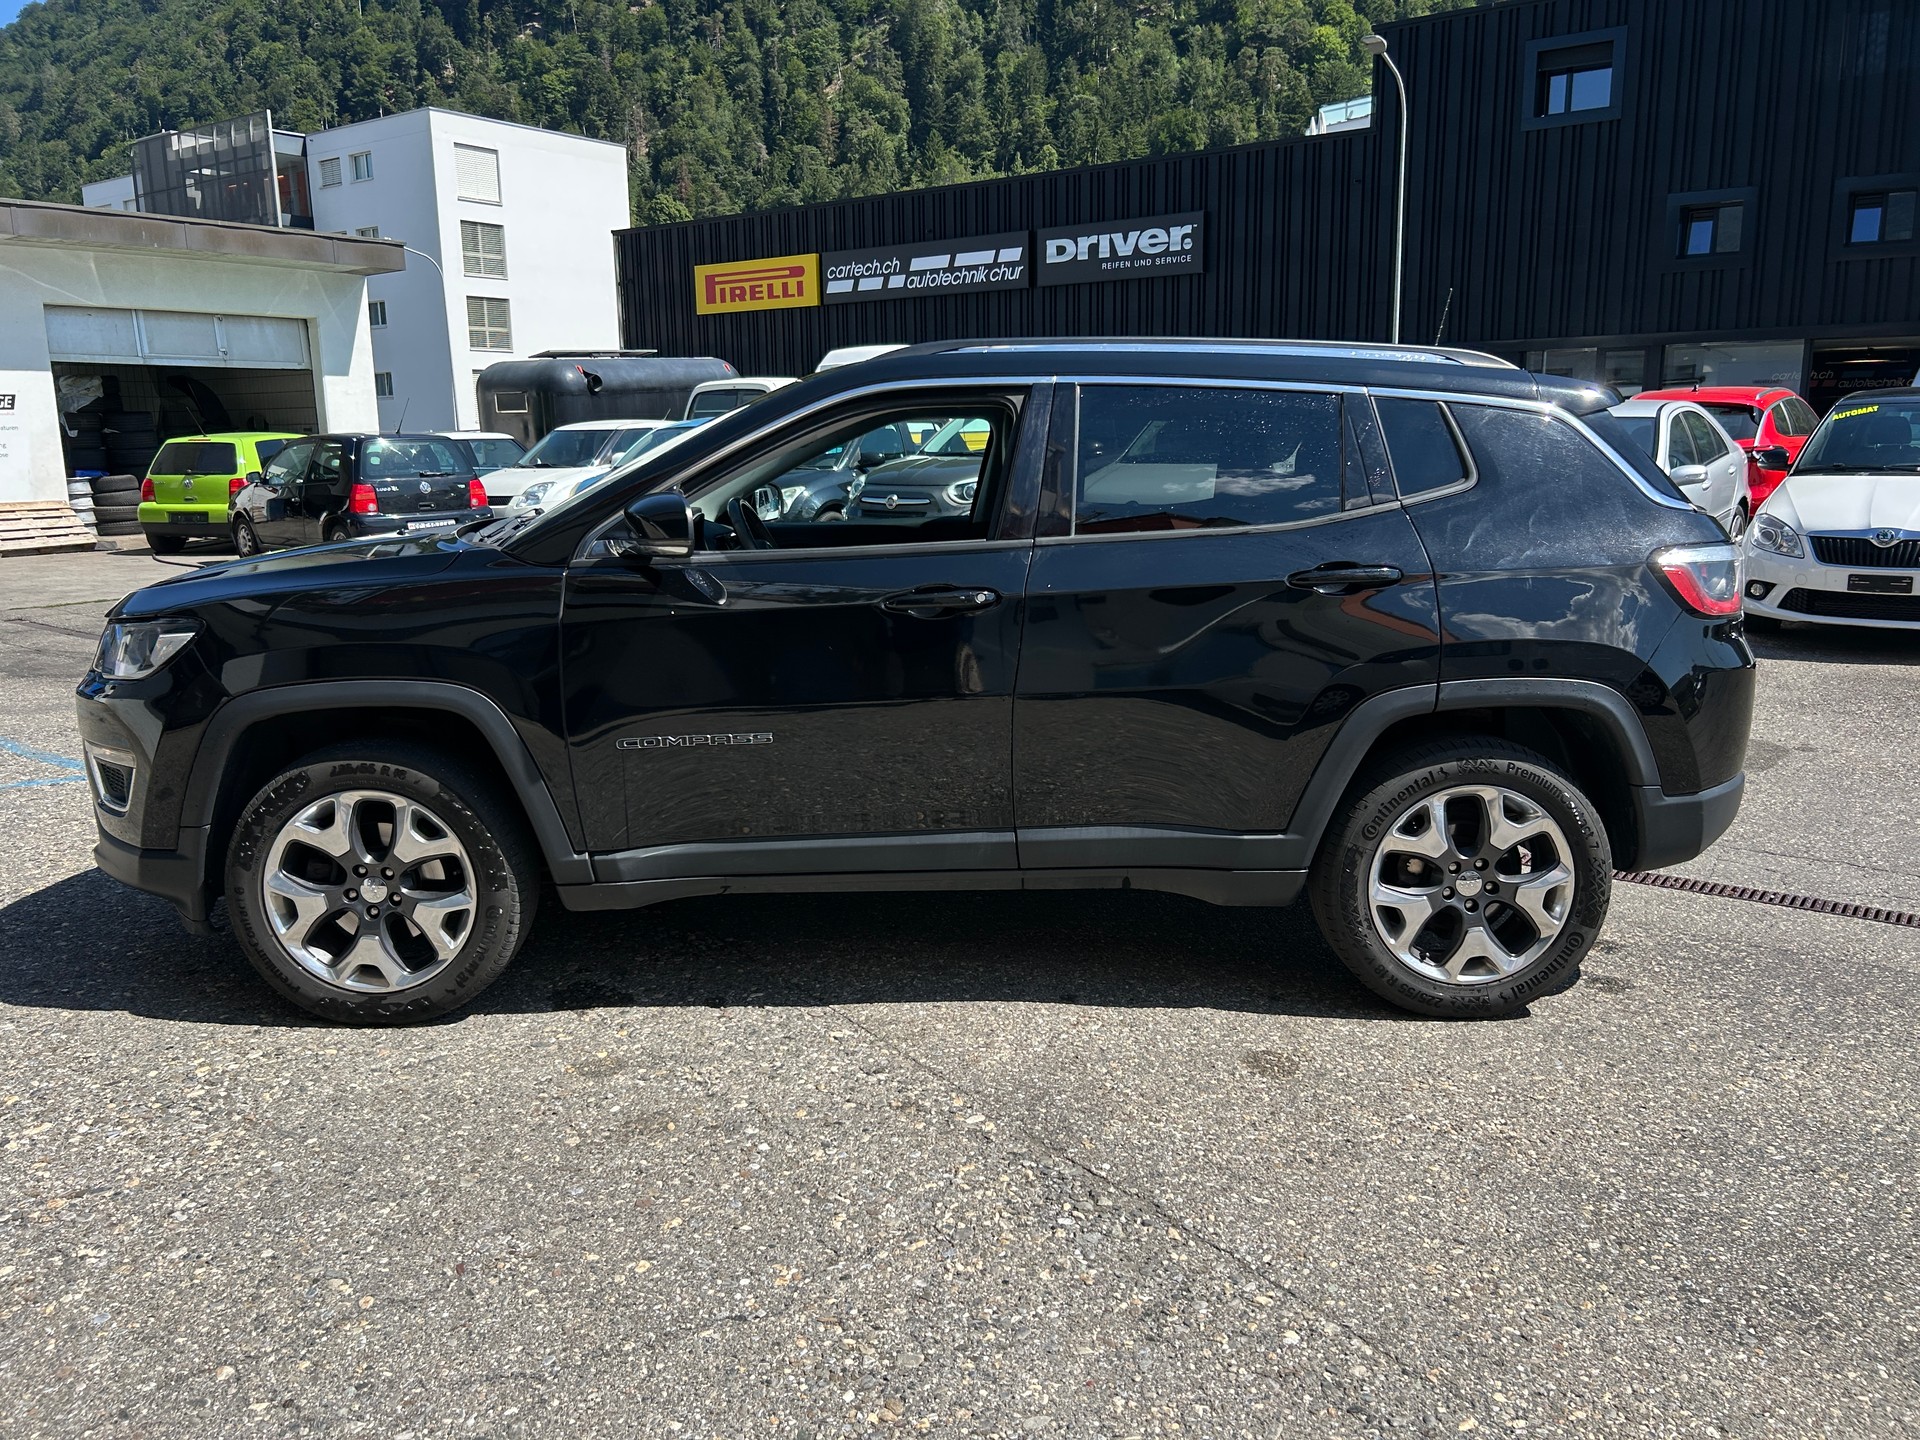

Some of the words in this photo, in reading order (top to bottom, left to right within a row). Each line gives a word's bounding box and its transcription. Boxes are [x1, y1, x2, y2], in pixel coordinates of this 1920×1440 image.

[827, 257, 900, 279] cartech.ch
[1101, 260, 1131, 270] REIFEN
[1134, 258, 1152, 267] UND
[1155, 254, 1192, 265] SERVICE
[705, 265, 805, 305] PIRELLI
[907, 266, 988, 289] autotechnik
[989, 264, 1024, 282] chur
[1832, 405, 1879, 421] AUTOMAT
[616, 732, 773, 750] COMPASS
[1362, 770, 1436, 841] Continental
[1511, 931, 1585, 1000] Continental
